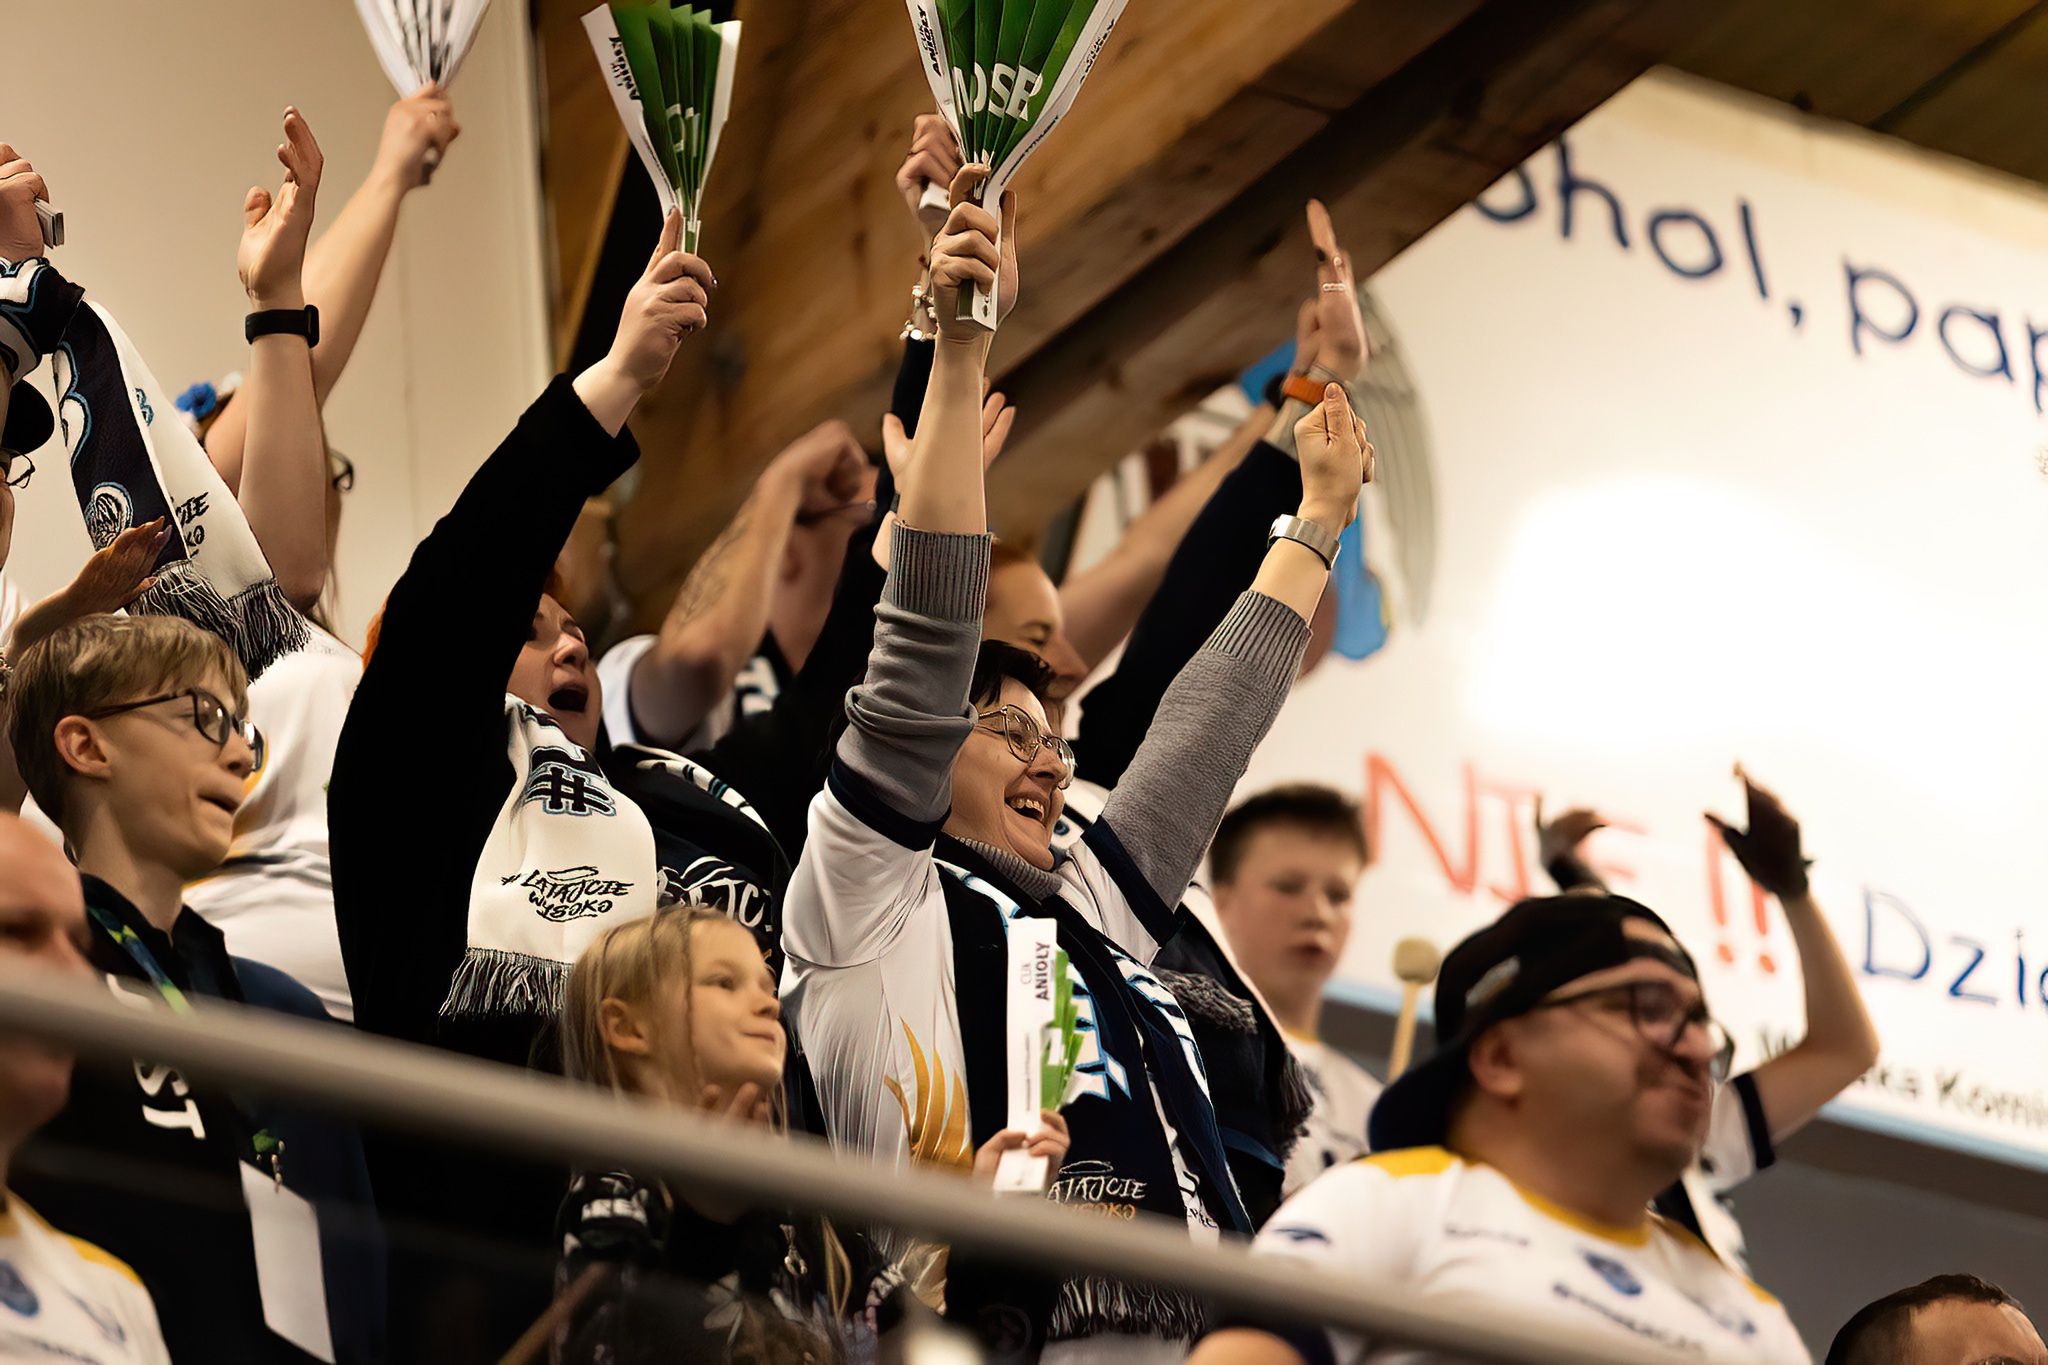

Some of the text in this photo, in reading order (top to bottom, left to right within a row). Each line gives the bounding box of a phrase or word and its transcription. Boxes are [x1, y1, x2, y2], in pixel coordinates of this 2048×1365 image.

[1475, 132, 2048, 413] ohol, pa
[1861, 886, 2048, 1009] Dzi
